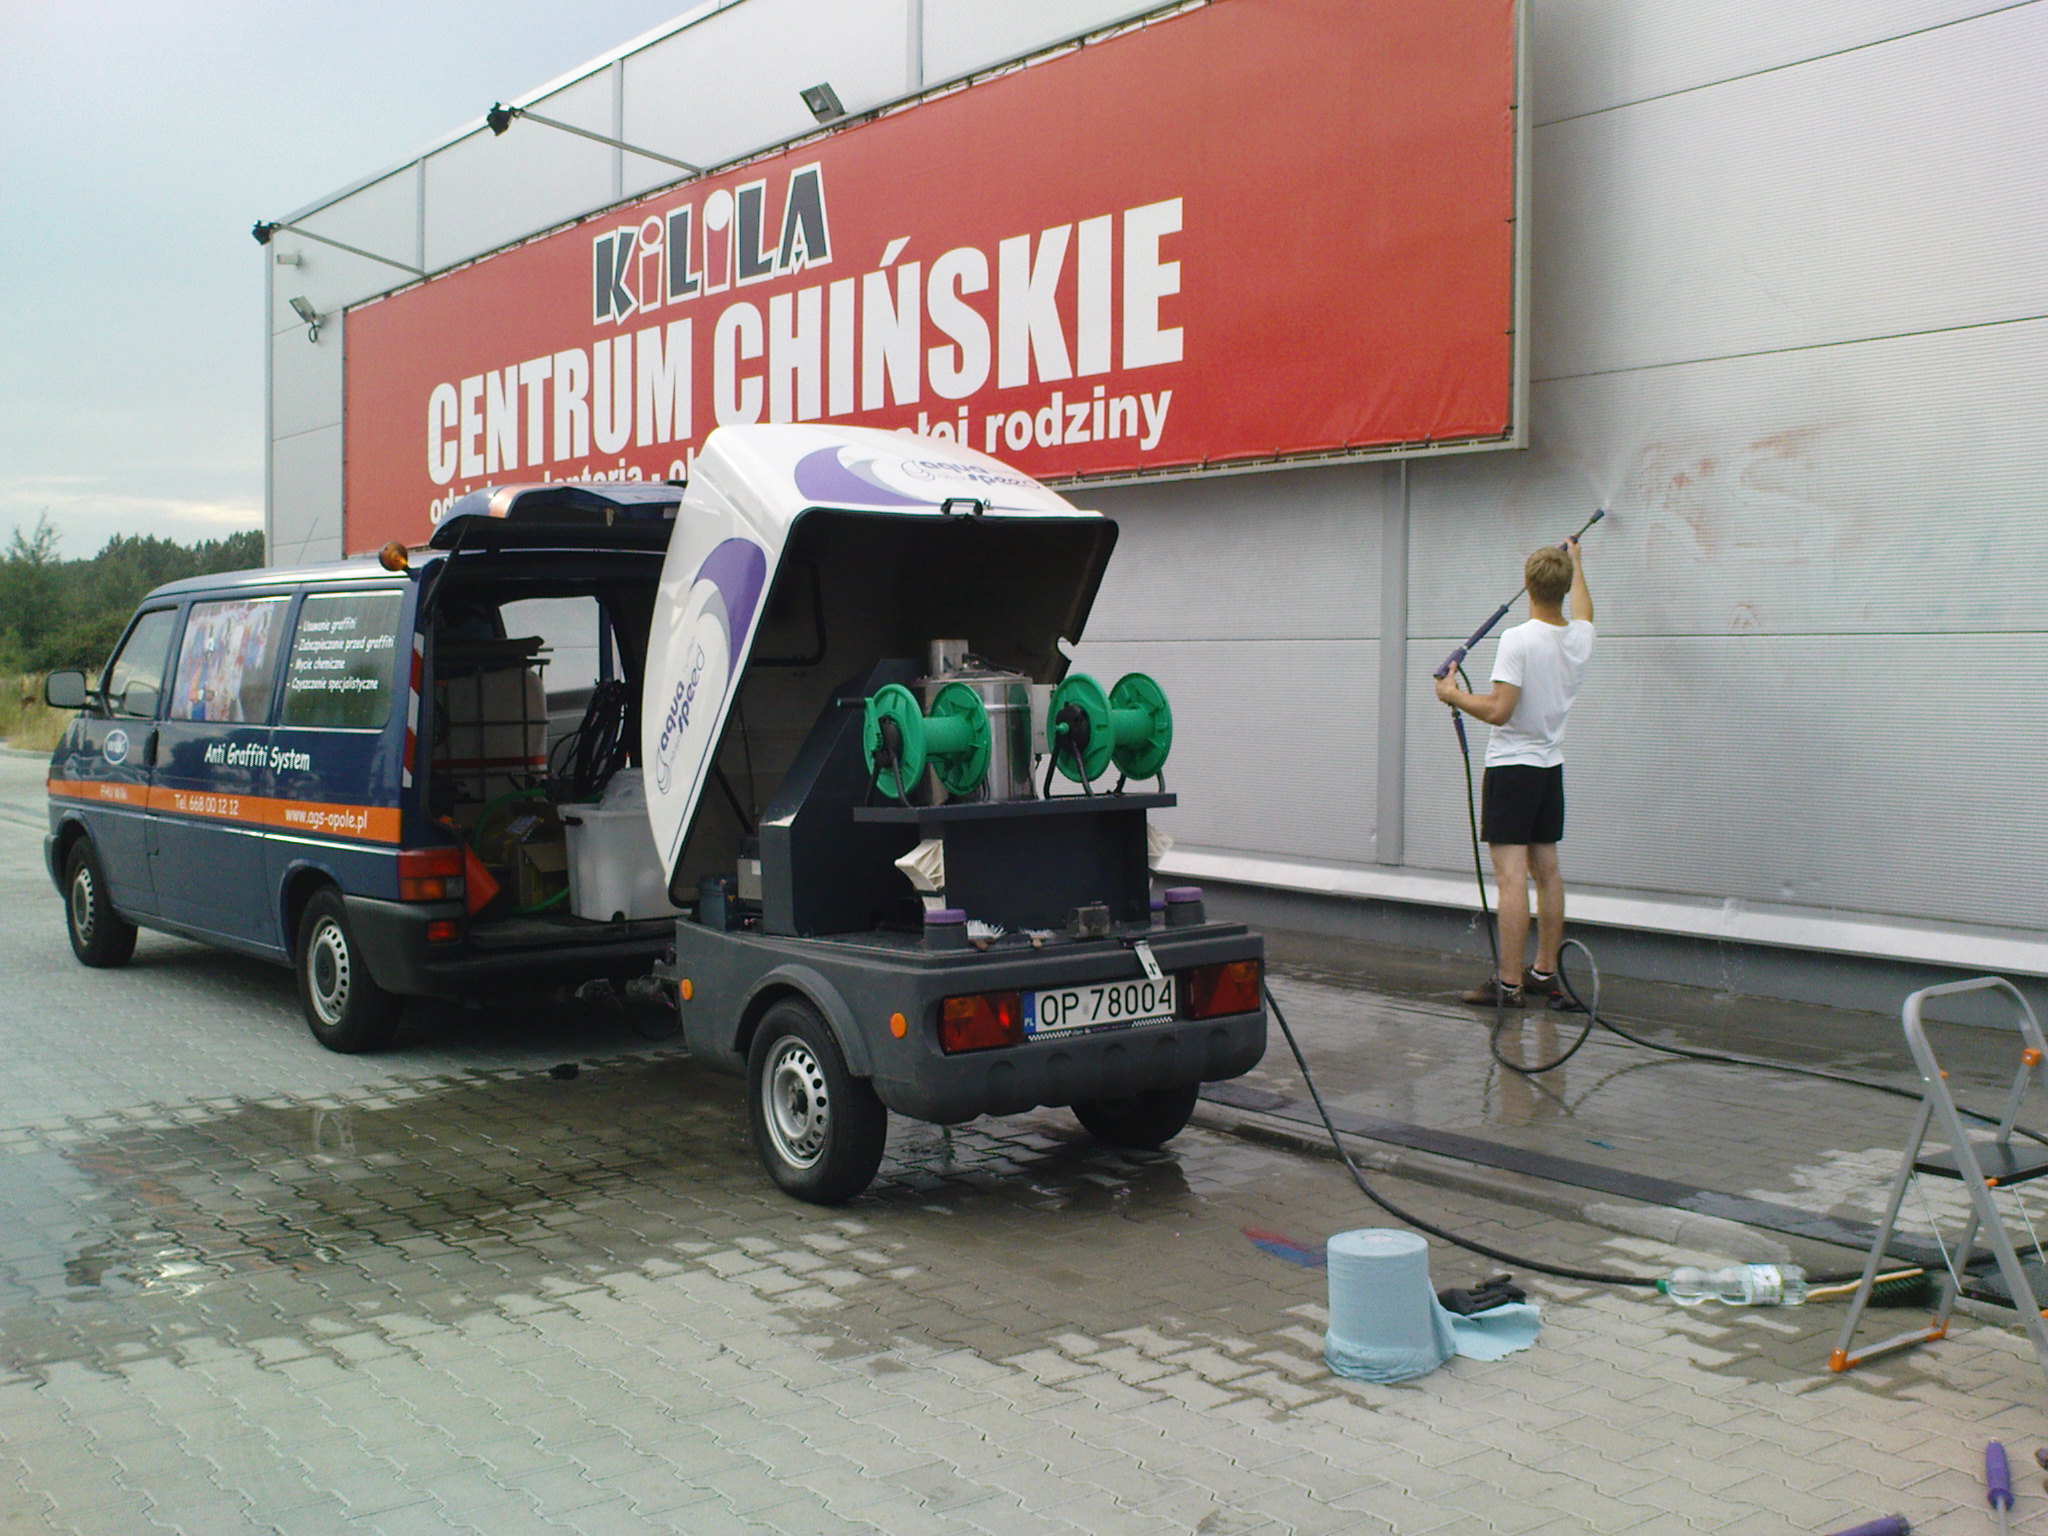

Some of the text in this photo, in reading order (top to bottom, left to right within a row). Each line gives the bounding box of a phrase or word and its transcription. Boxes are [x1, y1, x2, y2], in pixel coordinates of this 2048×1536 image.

[427, 196, 1184, 485] CENTRUM CHIŃSKIE
[985, 385, 1173, 453] rodziny
[330, 616, 358, 634] graffiti
[344, 636, 367, 653] przed
[365, 635, 396, 652] graffiti
[660, 681, 685, 751] aqua
[204, 742, 311, 775] Anti Graffiti System
[174, 793, 239, 816] Tel. 668 00 12 12
[285, 809, 368, 834] www.ags-opole.pl
[1024, 980, 1173, 1027] PL OP 78004
